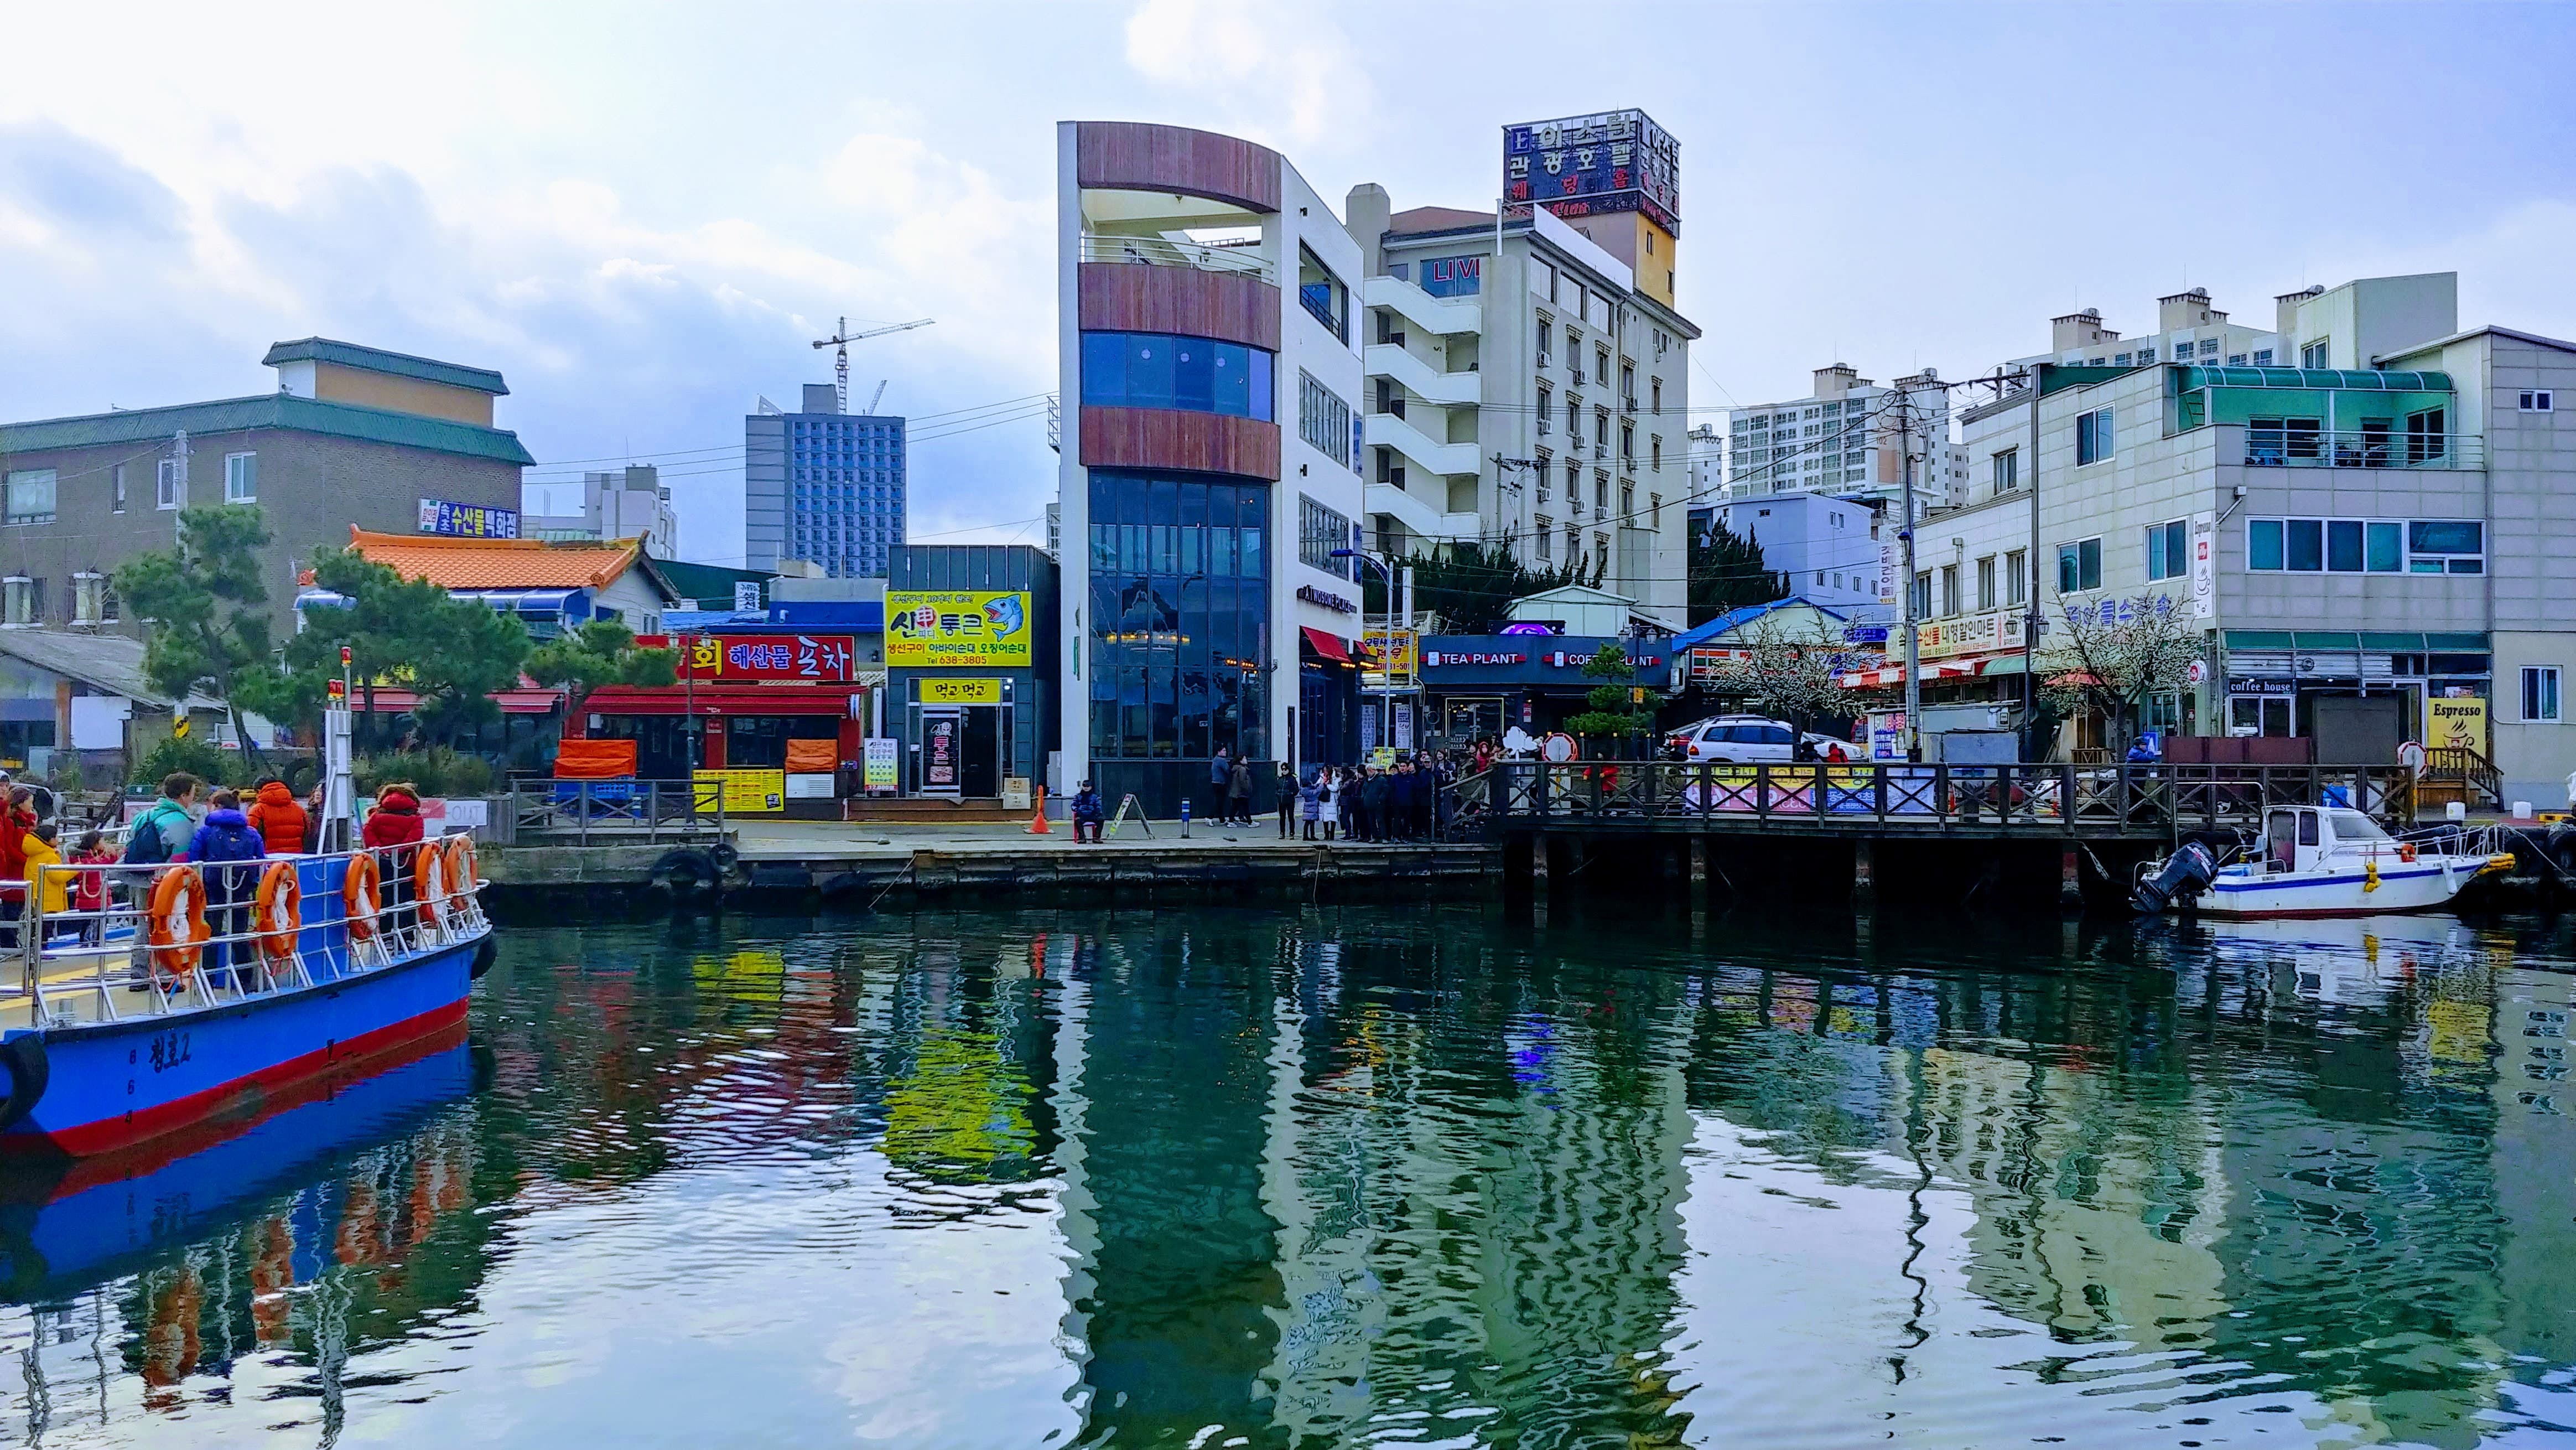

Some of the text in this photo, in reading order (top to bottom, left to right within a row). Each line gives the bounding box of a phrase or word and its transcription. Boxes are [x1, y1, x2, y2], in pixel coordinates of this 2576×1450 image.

[1539, 114, 1630, 149] 이스턴
[1509, 143, 1630, 179] 관광호텔
[1512, 168, 1629, 200] 웨딩홀
[1877, 437, 1887, 445] 102
[440, 504, 450, 531] 속초
[2194, 521, 2211, 537] Espresso
[891, 594, 924, 603] 생선구이
[927, 594, 953, 603] 10가지
[1335, 594, 1351, 612] PLACE
[890, 611, 917, 638] 신
[940, 614, 983, 636] 통큰
[1942, 618, 1995, 644] 대형할인마트
[887, 643, 1027, 654] 생선구이 아바이순대 오징어순대
[690, 635, 851, 681] 회 해산물 포차
[939, 656, 987, 665] 638-3805
[1442, 654, 1518, 664] TEA PLANT
[934, 683, 987, 699] 먹고 먹고
[2230, 681, 2291, 691] coffee house
[2433, 703, 2481, 719] Espresso
[933, 736, 949, 765] 통큰
[127, 1079, 135, 1095] 6
